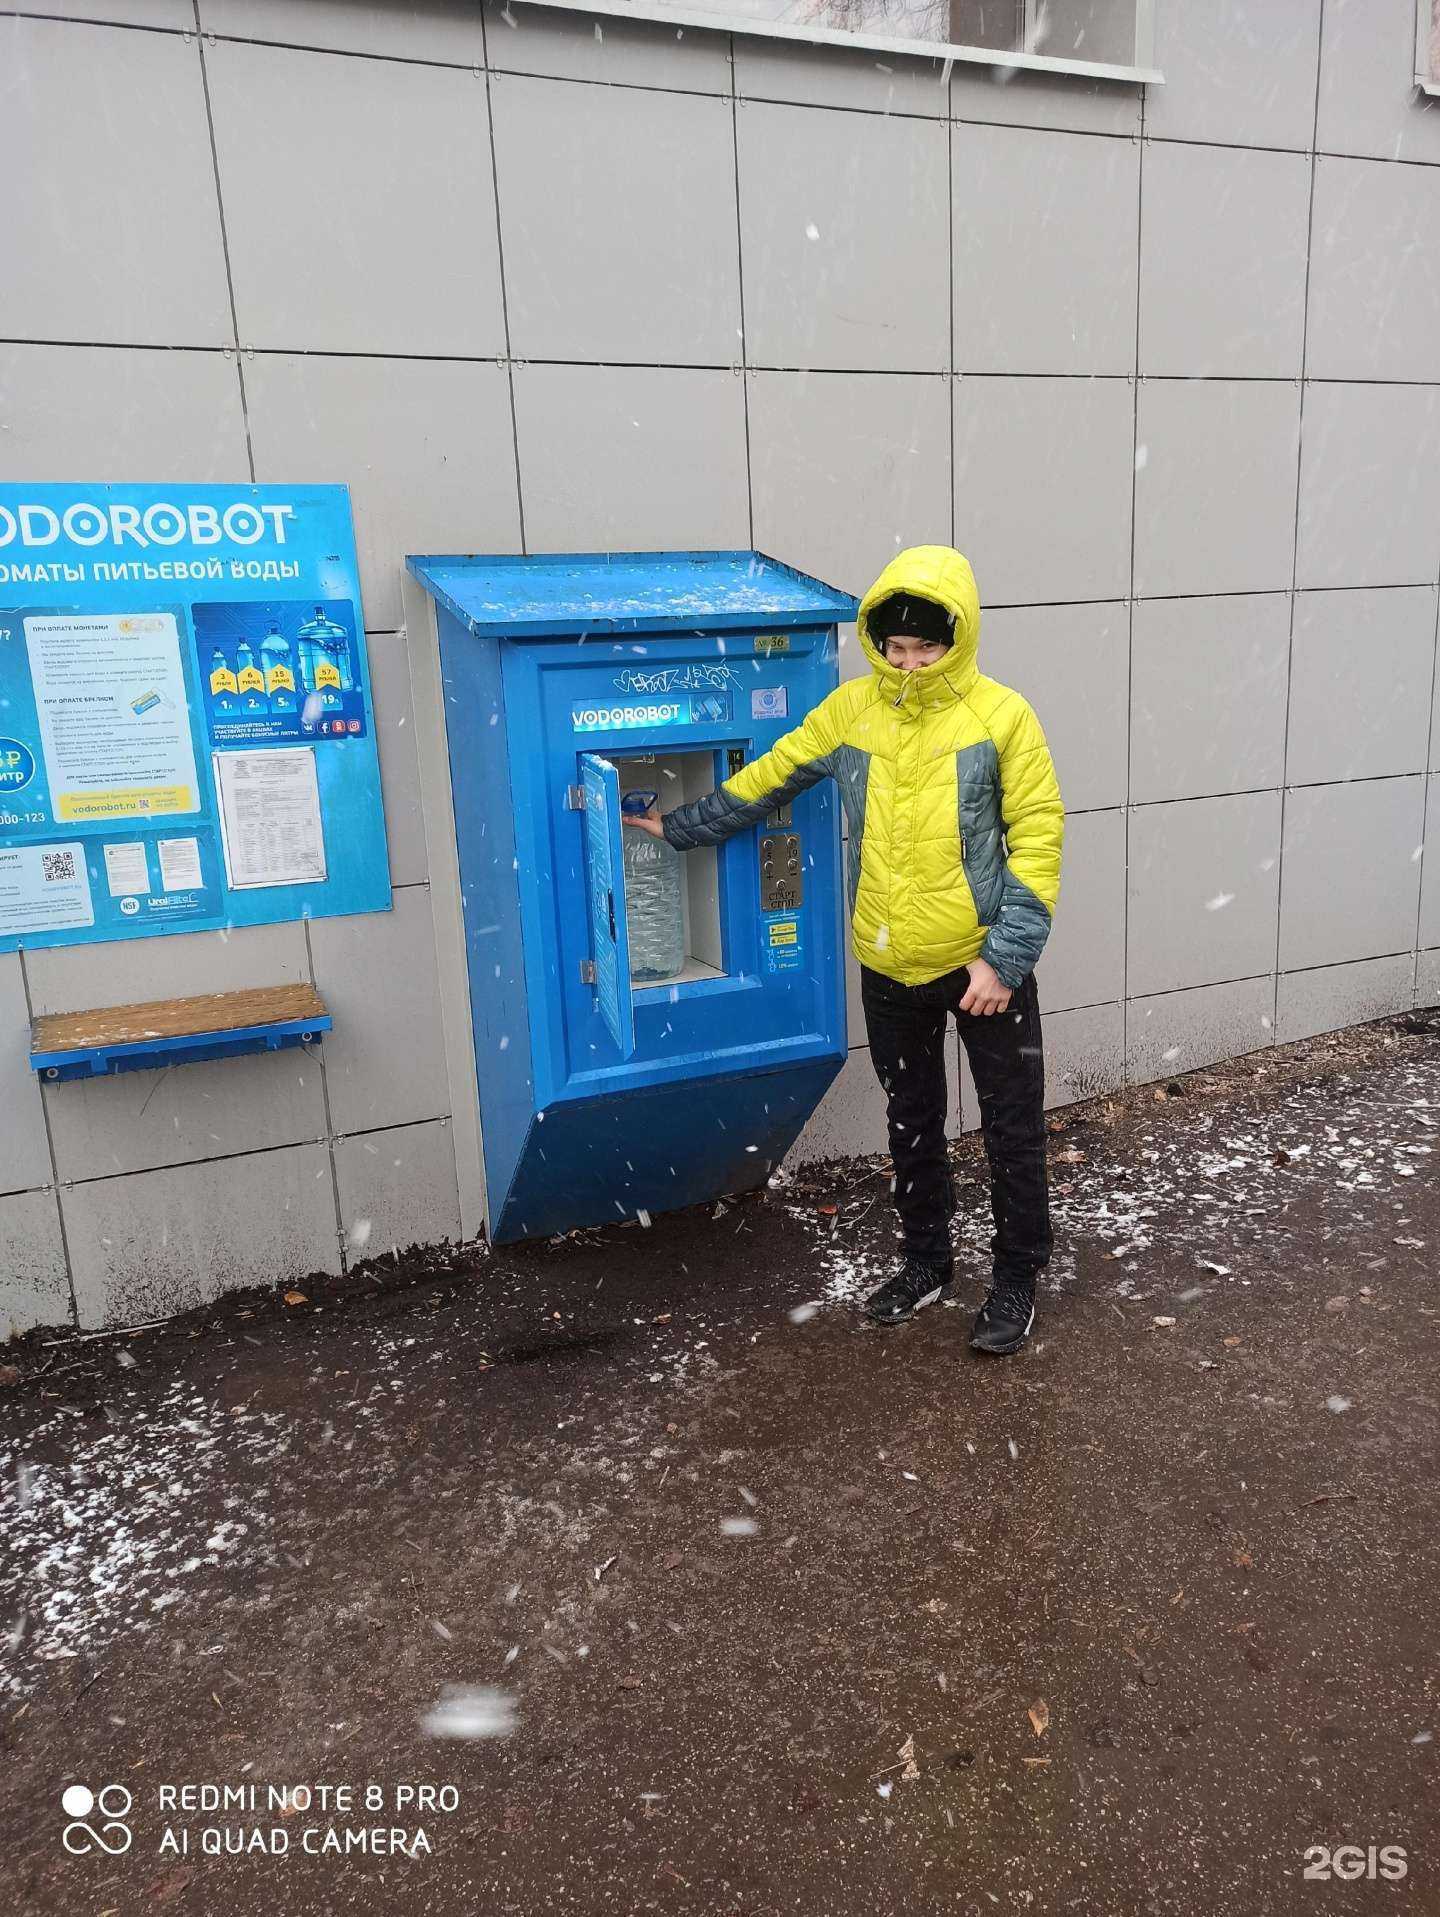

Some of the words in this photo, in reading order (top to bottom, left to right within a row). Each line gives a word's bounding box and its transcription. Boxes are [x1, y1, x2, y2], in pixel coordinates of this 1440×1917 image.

[93, 557, 223, 581] ПИТЬЕВОЙ
[231, 559, 300, 582] ВОДЫ
[771, 636, 784, 648] 36
[274, 670, 285, 678] 15
[321, 668, 331, 676] 57
[572, 704, 681, 726] VODOROBOT
[72, 802, 137, 814] vodorobot.ru
